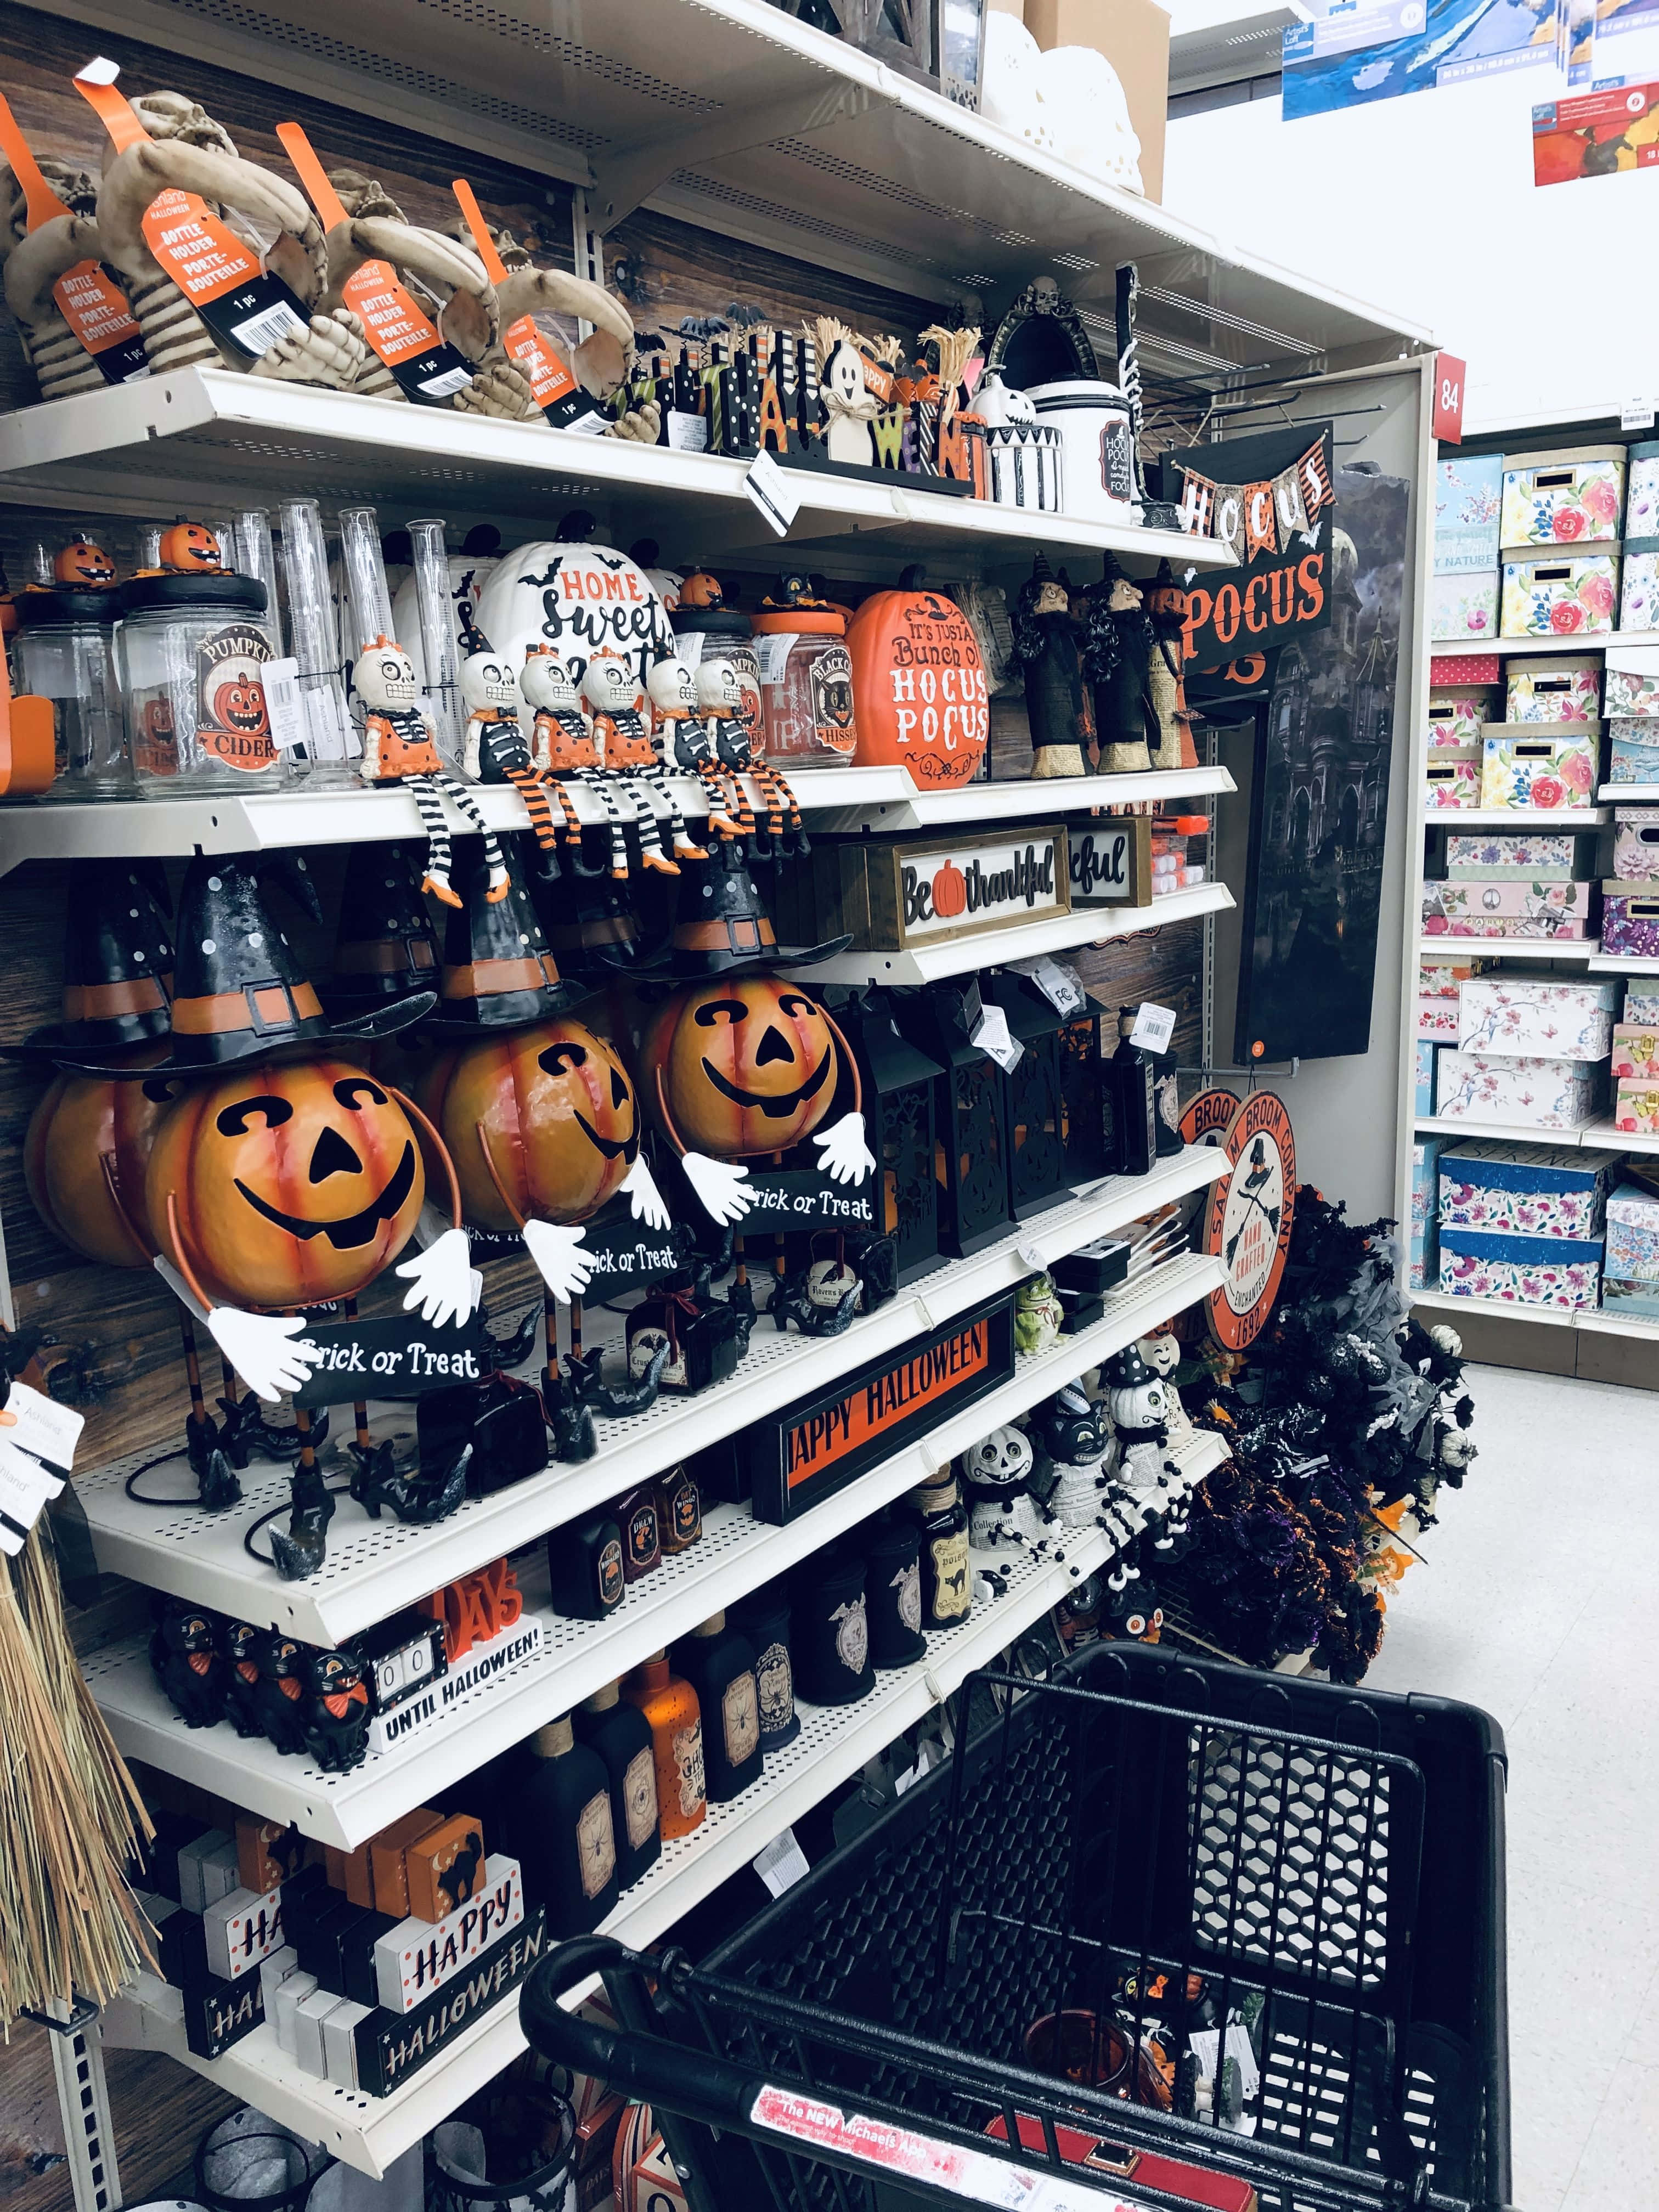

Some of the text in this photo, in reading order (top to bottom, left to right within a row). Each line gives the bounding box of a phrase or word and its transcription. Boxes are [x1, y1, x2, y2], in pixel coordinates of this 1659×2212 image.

[150, 204, 190, 220] HALLOWEEN
[160, 223, 205, 246] BOTTLE
[168, 236, 217, 261] HOLDER
[182, 252, 228, 276] PORTE-
[185, 257, 250, 293] BOUTEILLE
[61, 274, 95, 295] BOTTLE
[351, 276, 385, 292] HALLOWEEN
[67, 288, 106, 310] HOLDER
[233, 294, 257, 309] 1 pc
[360, 292, 397, 313] BOTTLE
[78, 305, 116, 325] PORTE-
[82, 312, 136, 342] BOUTEILLE
[366, 305, 407, 326] HOLDER
[377, 320, 415, 341] PORTE-
[380, 328, 432, 356] BOUTEILLE
[123, 348, 144, 362] 1 pc
[514, 339, 538, 357] BOTTLE
[418, 360, 438, 373] 1 pc
[533, 371, 568, 397] BOUTEILLE
[1441, 379, 1459, 414] 84
[561, 403, 577, 415] 1 pc
[1182, 456, 1323, 543] HOCUS
[1445, 554, 1493, 567] NATURE
[561, 571, 644, 601] HOME
[541, 589, 659, 646] Sweet
[1181, 552, 1324, 661] POCUS
[909, 623, 972, 642] IT'S JUST A
[891, 636, 961, 667] Bunch
[814, 658, 843, 681] BLACK
[889, 669, 987, 704] HOCUS
[895, 704, 988, 751] POCUS
[214, 735, 274, 758] CIDER
[901, 845, 1053, 926] Be thankful
[1466, 918, 1513, 927] PARIS
[1055, 988, 1072, 1005] FC
[1459, 1147, 1589, 1168] SPRING
[1212, 1098, 1296, 1257] SALM BROOM COMPANY
[793, 1196, 816, 1214] or
[819, 1191, 873, 1220] Treat
[1244, 1220, 1261, 1251] HAND
[618, 1252, 635, 1272] or
[635, 1243, 678, 1269] Treat
[1236, 1242, 1265, 1282] CRAFTED
[812, 1285, 837, 1296] Raven's
[1234, 1271, 1265, 1307] ENCHANTED
[1236, 1307, 1260, 1347] 1692
[371, 1351, 403, 1374] or
[407, 1342, 480, 1378] Treat
[866, 1321, 982, 1426] HALLOWEEN
[0, 1465, 26, 1491] hland
[634, 1515, 653, 1534] BREW
[974, 1516, 1013, 1530] Collection
[386, 1628, 539, 1741] UNTIL HALLOWEEN!
[682, 1743, 703, 1779] GHO
[411, 1879, 512, 1989] HAPPY
[385, 1927, 545, 2076] HALLOWEEN
[781, 2101, 803, 2117] The
[806, 2107, 838, 2129] NEW
[899, 2141, 926, 2160] App
